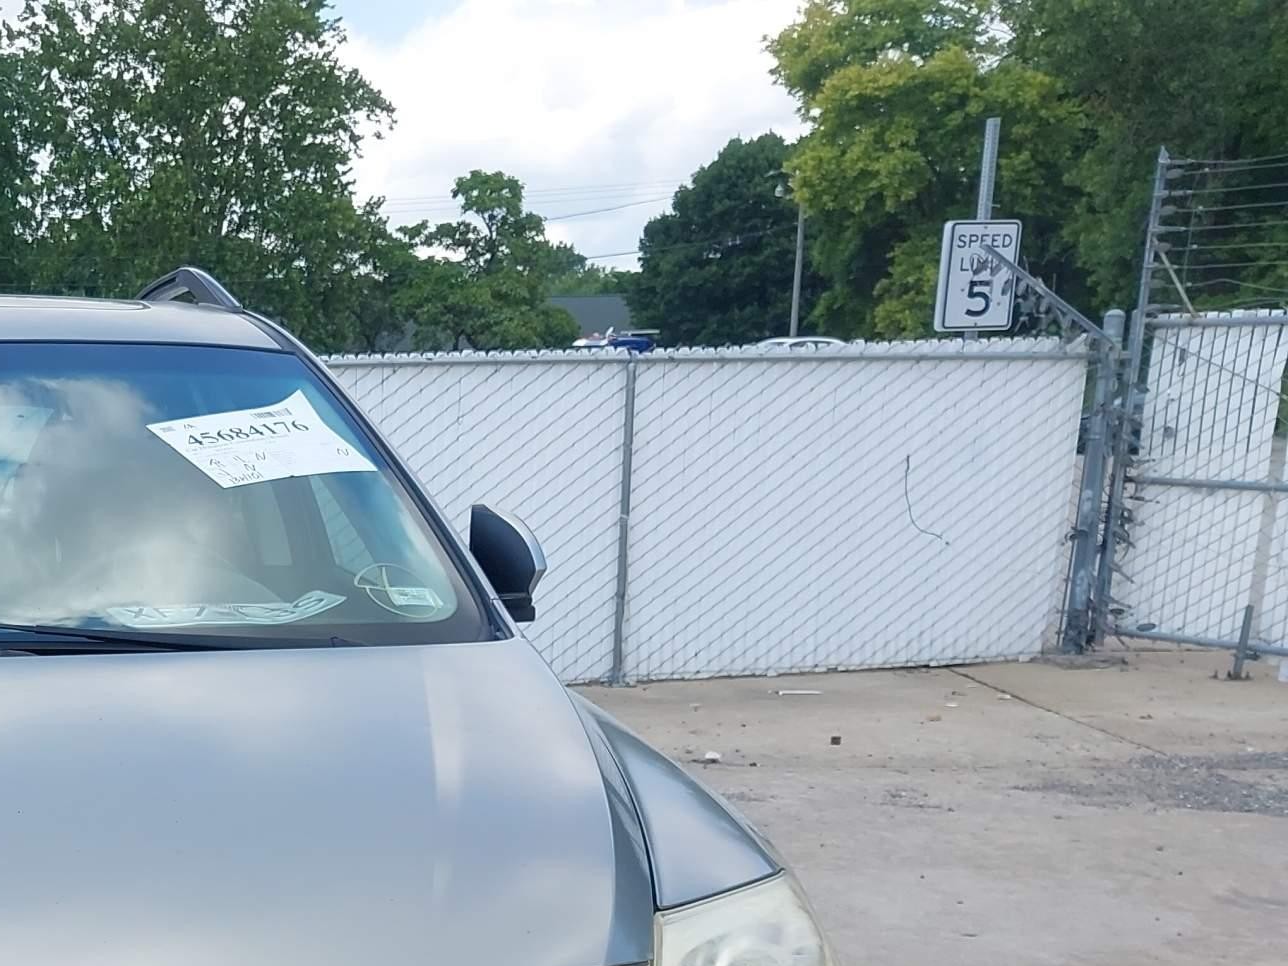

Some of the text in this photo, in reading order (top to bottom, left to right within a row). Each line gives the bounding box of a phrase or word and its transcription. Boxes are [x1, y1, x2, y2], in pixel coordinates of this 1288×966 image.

[957, 233, 1013, 248] SPEED
[965, 280, 991, 317] 5
[188, 420, 309, 446] 45684176
